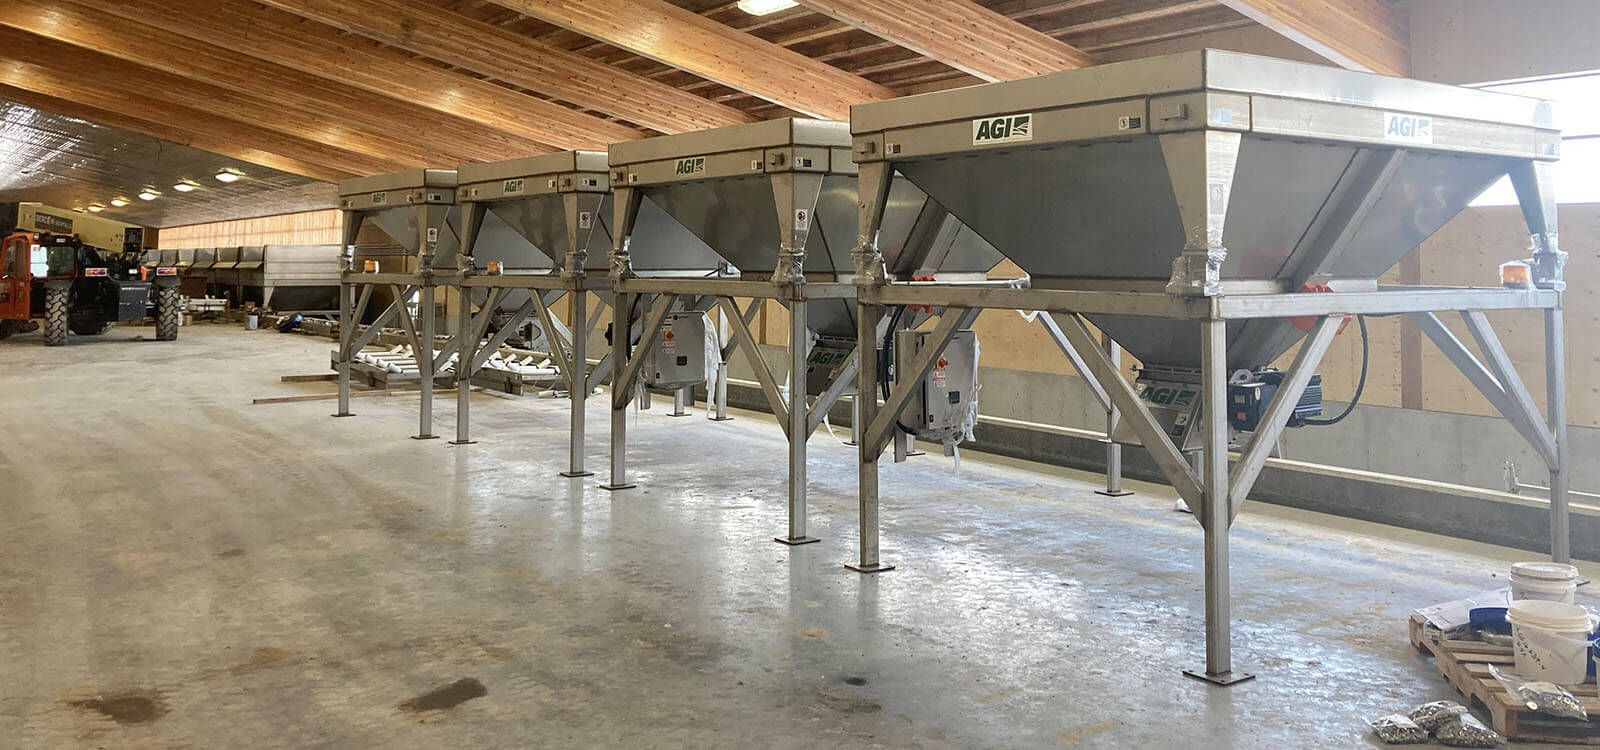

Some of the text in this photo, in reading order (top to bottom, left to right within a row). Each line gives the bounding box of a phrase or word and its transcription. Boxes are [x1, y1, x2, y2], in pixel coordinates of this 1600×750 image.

[976, 117, 1013, 141] AGI
[1387, 115, 1416, 137] AGI
[676, 159, 694, 175] AGI
[505, 181, 517, 193] AGI
[809, 352, 835, 365] AGI
[1140, 386, 1179, 405] AGI
